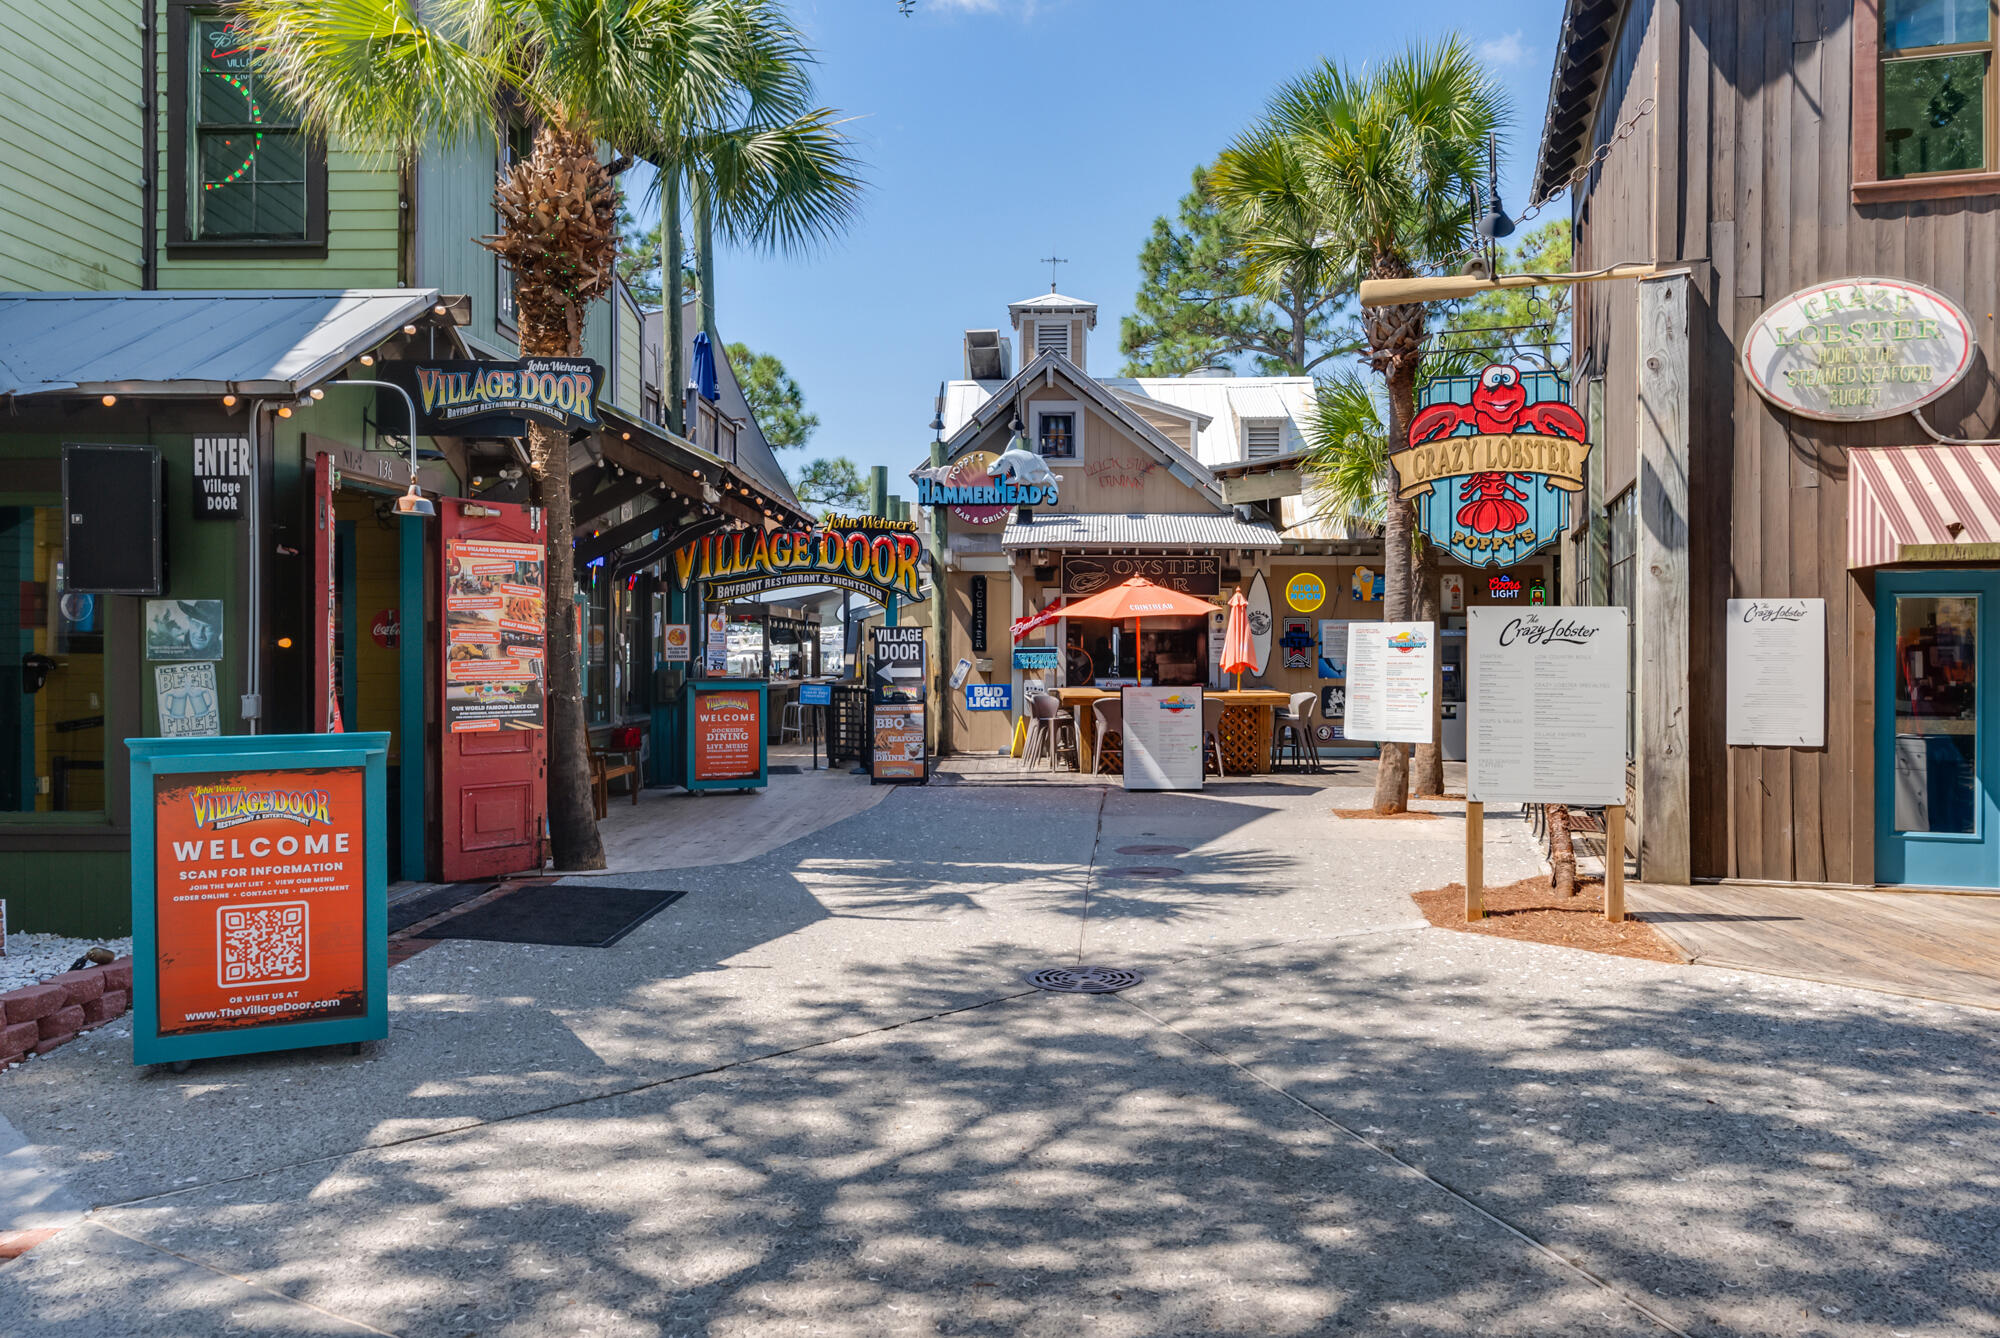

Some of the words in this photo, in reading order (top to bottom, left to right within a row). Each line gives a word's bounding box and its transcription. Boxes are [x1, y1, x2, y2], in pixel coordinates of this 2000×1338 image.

[1804, 286, 1915, 319] CRAZY
[1776, 318, 1943, 347] LOBSTER
[1818, 347, 1848, 364] HOME
[1874, 345, 1896, 362] THE
[526, 359, 550, 374] John
[550, 359, 591, 374] Wehner's
[1787, 366, 1857, 387] STEAMED
[1861, 364, 1934, 384] SEAFOOD
[416, 366, 516, 415] VILLAGE
[519, 371, 596, 423] DOOR
[1829, 387, 1882, 406] BUCKET
[447, 404, 479, 418] BAYFRONT
[480, 401, 519, 411] RESTAURANT
[527, 402, 563, 420] NIGHTCLUB
[194, 438, 250, 476] ENTER
[1413, 439, 1478, 480] CRAZY
[1486, 438, 1572, 474] LOBSTER
[950, 453, 984, 480] POPPY'S
[203, 479, 240, 497] Village
[207, 497, 238, 510] DOOR
[823, 513, 863, 533] John
[858, 516, 917, 531] Wehner's
[954, 507, 970, 522] BAR
[982, 507, 1009, 524] GRILLE
[1452, 528, 1537, 551] POPPY'S
[674, 526, 813, 591] VILLAGE
[816, 530, 925, 602] DOOR
[1113, 559, 1217, 575] OYSTER
[717, 581, 763, 599] BAYFRONT
[765, 574, 821, 591] RESTAURANT
[822, 575, 831, 583] &
[832, 577, 882, 600] NIGHTCLUB
[1293, 584, 1319, 592] HIGH
[1489, 577, 1521, 590] Coors
[1290, 592, 1320, 600] NOON
[1491, 589, 1519, 598] LIGHT
[1526, 613, 1539, 624] The
[1744, 605, 1774, 623] Crazy
[1770, 605, 1808, 622] Lobster
[876, 629, 922, 642] VILLAGE
[1499, 618, 1547, 647] Crazy
[1541, 618, 1600, 645] Lobster
[879, 643, 920, 660] DOOR
[181, 664, 211, 672] COLD
[160, 671, 214, 694] BEER
[974, 686, 1003, 697] BUD
[968, 697, 1009, 708] LIGHT
[162, 710, 218, 734] FREE
[700, 713, 756, 722] WELCOME
[875, 718, 905, 730] BBQ
[706, 732, 749, 741] DINING
[888, 735, 923, 743] SEAFOOD
[194, 785, 215, 797] John
[189, 790, 272, 828] VILLAGE
[272, 789, 333, 825] DOOR
[216, 814, 254, 830] RESTAURANT
[261, 813, 310, 826] ENTERTAINMENT
[173, 833, 349, 862] WELCOME
[179, 868, 218, 881] SCAN
[221, 867, 247, 878] FOR
[251, 862, 343, 876] INFORMATION
[226, 881, 246, 889] WAIT
[248, 880, 264, 888] LIST
[173, 894, 199, 902] ORDER
[201, 892, 229, 900] ONLINE
[240, 889, 276, 897] CONTACT
[299, 885, 349, 894] EMPLOYMENT
[245, 994, 269, 1002] VISIT
[185, 999, 340, 1021] www.TheVillageDoor.com
